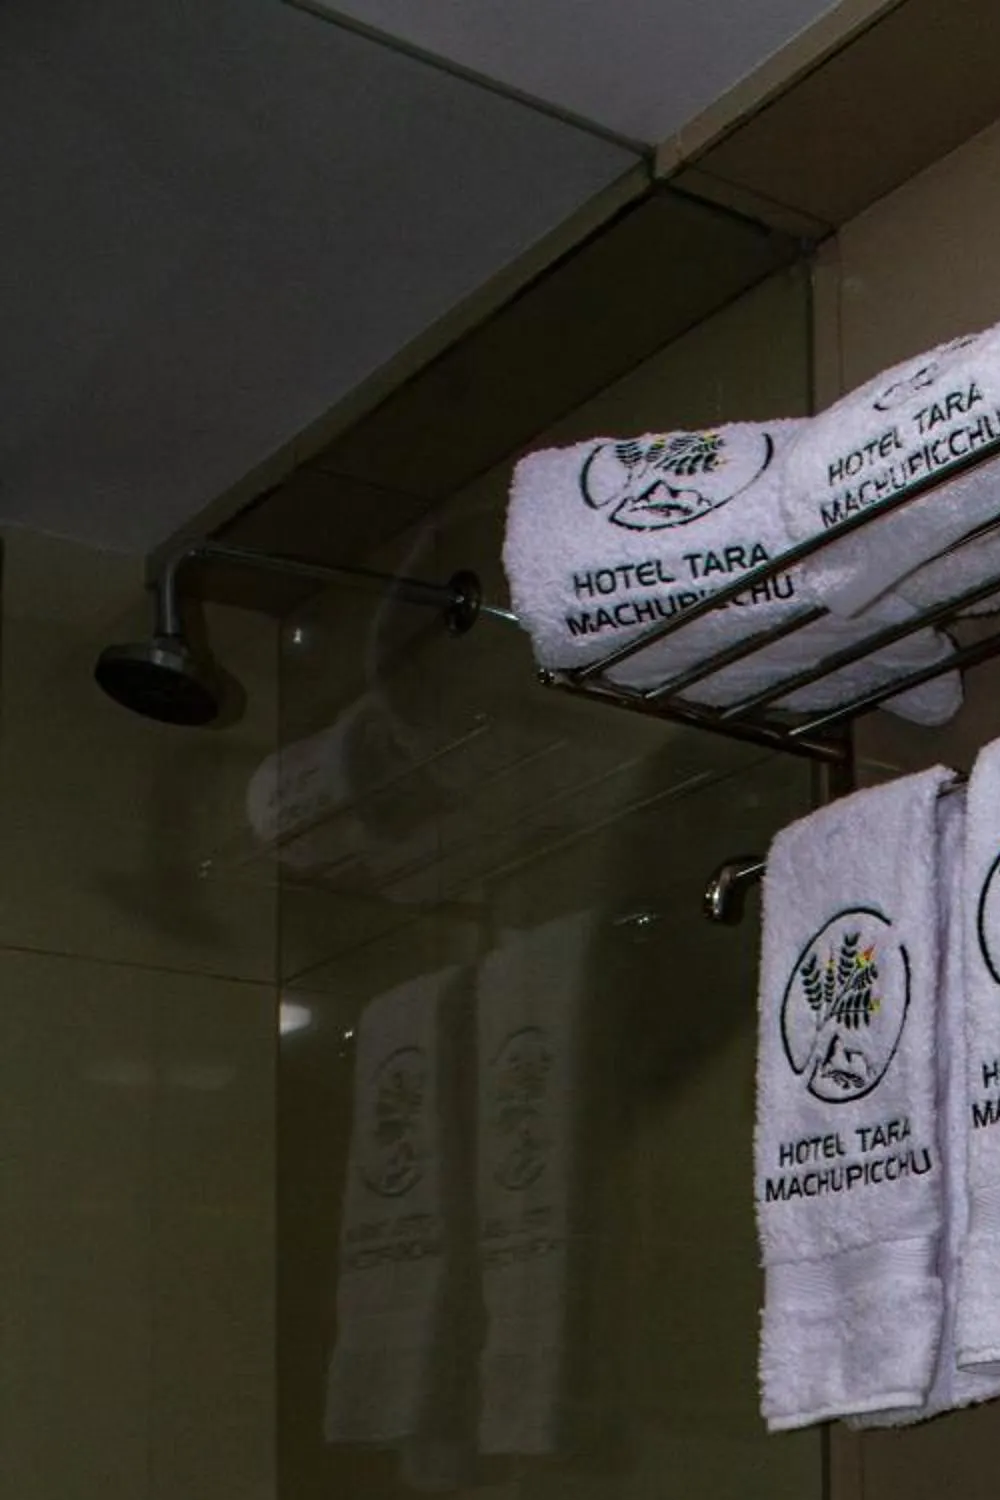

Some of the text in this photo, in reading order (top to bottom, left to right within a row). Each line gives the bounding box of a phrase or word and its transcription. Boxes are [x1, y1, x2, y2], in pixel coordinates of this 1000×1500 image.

[828, 383, 983, 486] HOTEL TARA
[573, 543, 769, 598] HOTEL TARA
[779, 1117, 911, 1168] HOTEL TARA
[765, 1148, 932, 1202] MACHUPICCHU
